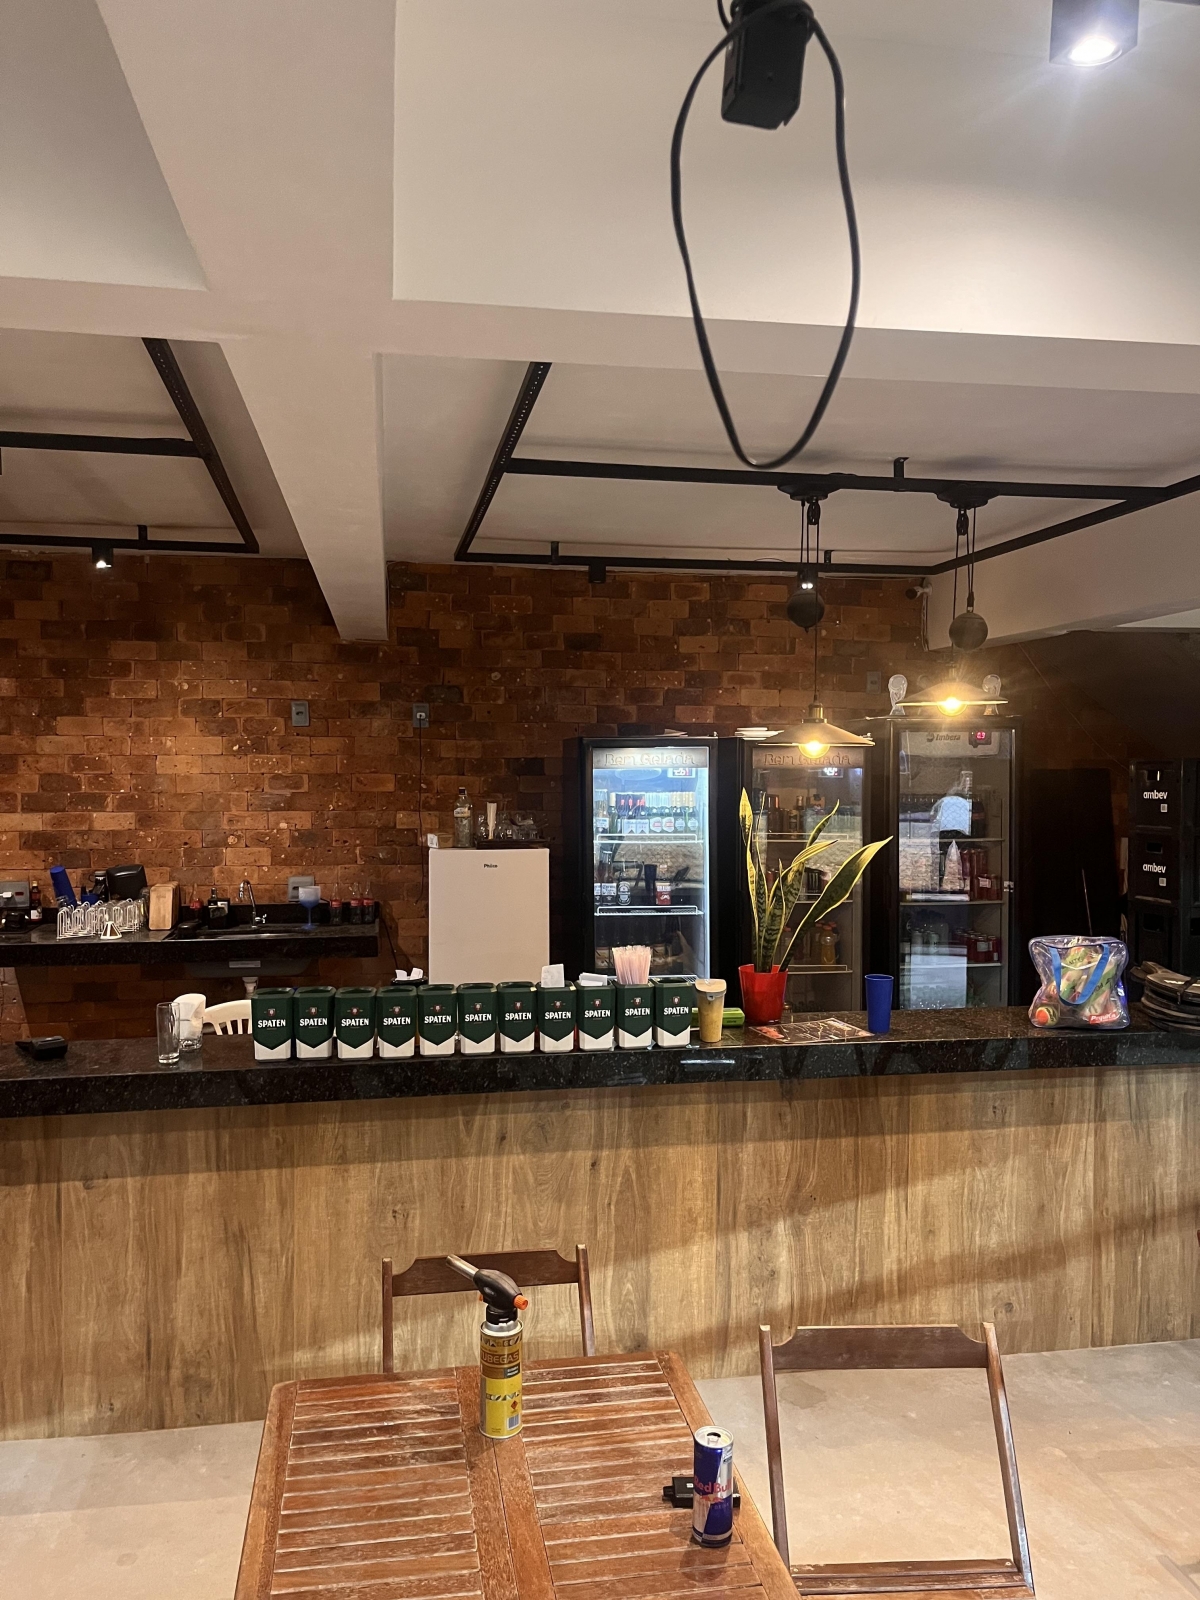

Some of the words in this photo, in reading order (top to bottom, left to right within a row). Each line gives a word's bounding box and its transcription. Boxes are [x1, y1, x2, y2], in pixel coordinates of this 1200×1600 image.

[1143, 789, 1168, 799] ambev
[1142, 862, 1167, 873] ambev
[584, 1009, 611, 1018] SPATEN
[624, 1007, 651, 1016] SPATEN
[663, 1006, 689, 1015] SPATEN
[424, 1015, 452, 1024] SPATEN
[464, 1013, 492, 1022] SPATEN
[504, 1012, 532, 1021] SPATEN
[544, 1011, 572, 1020] SPATEN
[257, 1019, 286, 1028] SPATEN
[299, 1017, 328, 1026] SPATEN
[341, 1018, 370, 1026] SPATEN
[382, 1016, 411, 1025] SPATEN
[694, 1475, 712, 1493] Red
[713, 1478, 732, 1493] Bull
